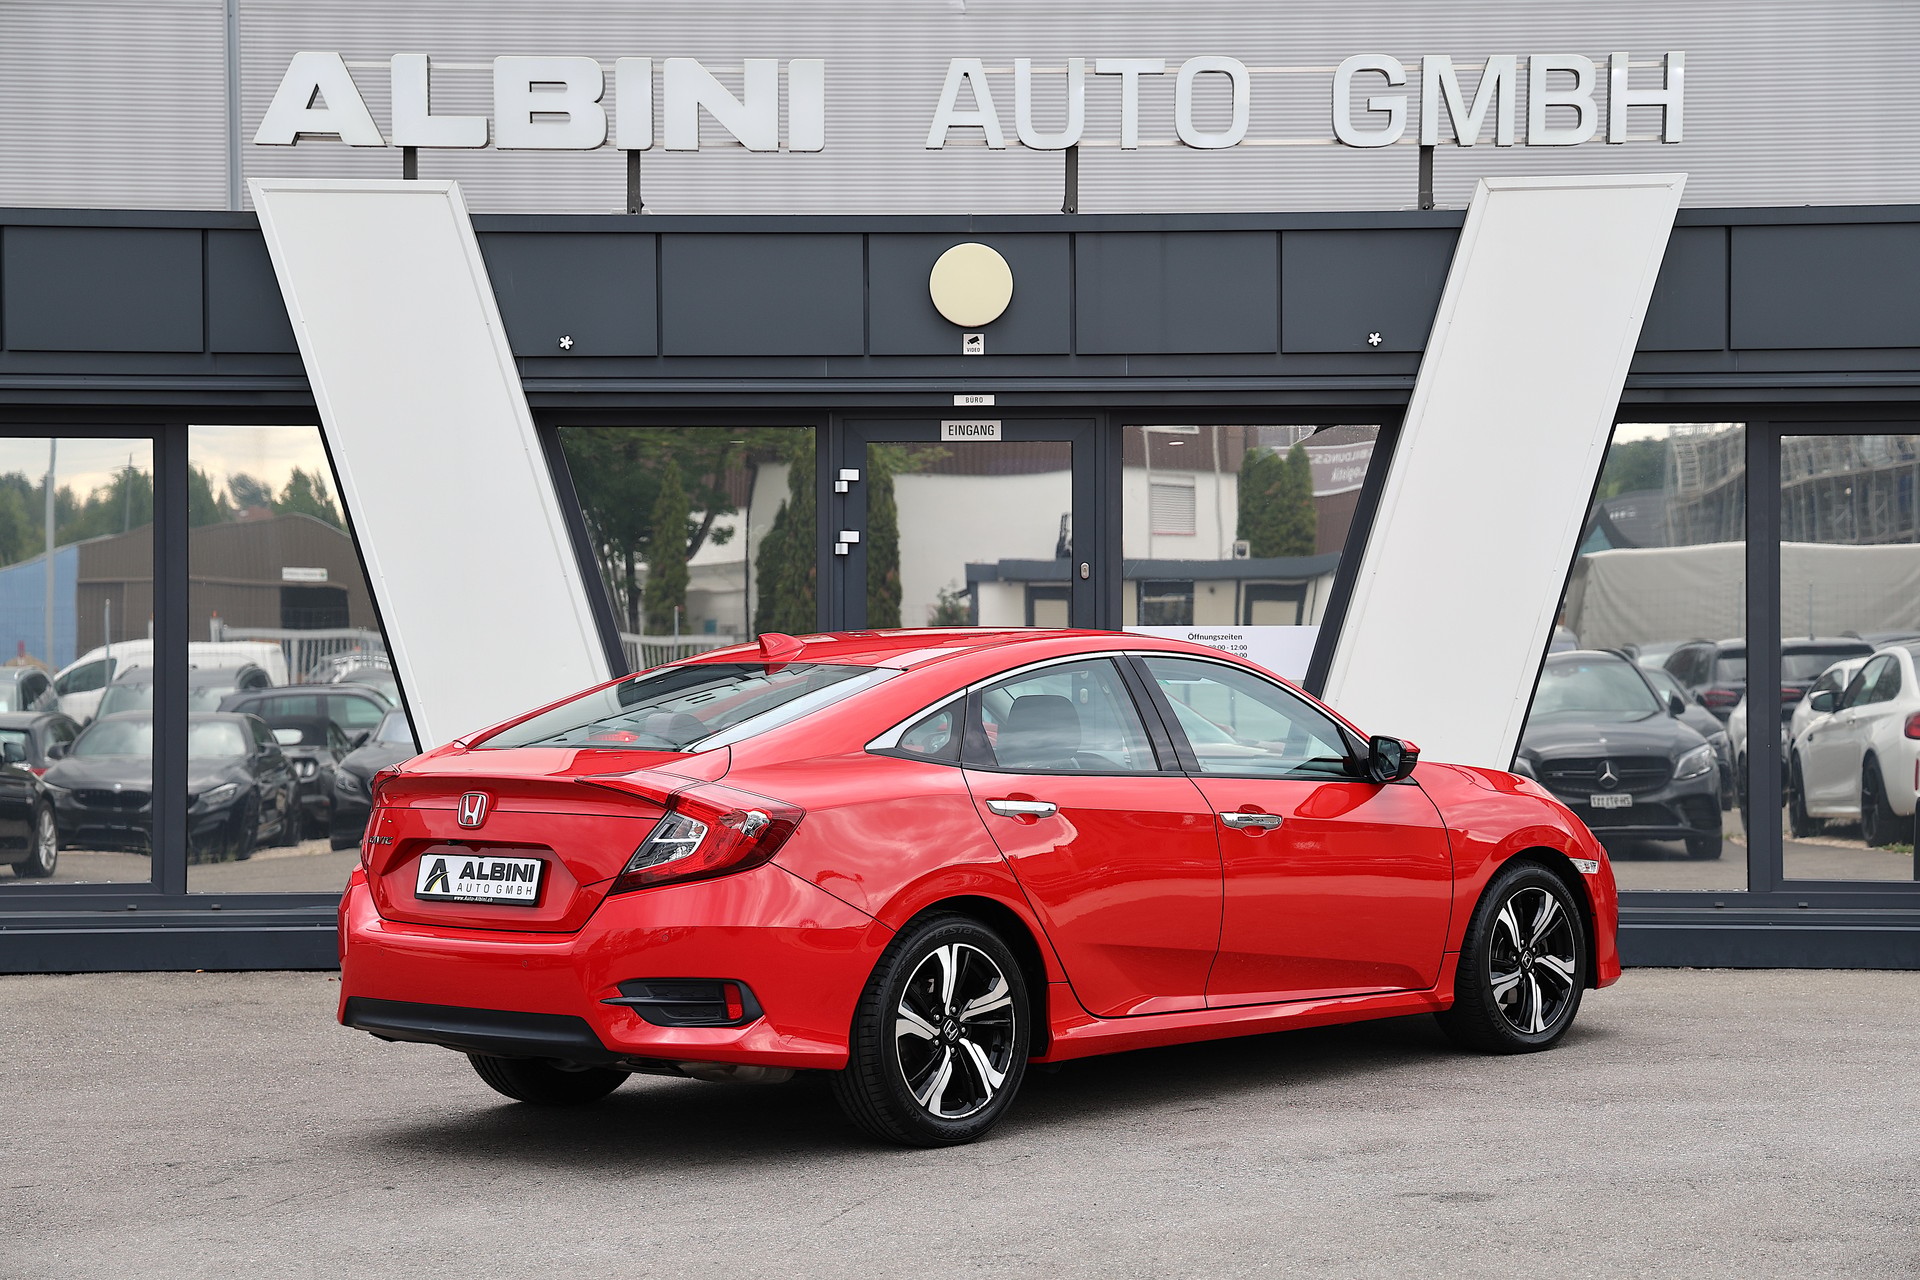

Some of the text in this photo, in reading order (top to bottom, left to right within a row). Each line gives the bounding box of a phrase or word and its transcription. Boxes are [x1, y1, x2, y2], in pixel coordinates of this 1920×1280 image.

[253, 50, 1686, 153] ALBINI AUTO GMBH
[965, 396, 984, 404] BÜRO
[948, 424, 995, 436] EINGANG
[1187, 633, 1243, 641] Öffnungszeiten
[459, 861, 536, 883] ALBINI
[457, 882, 533, 896] AUTO GMBH
